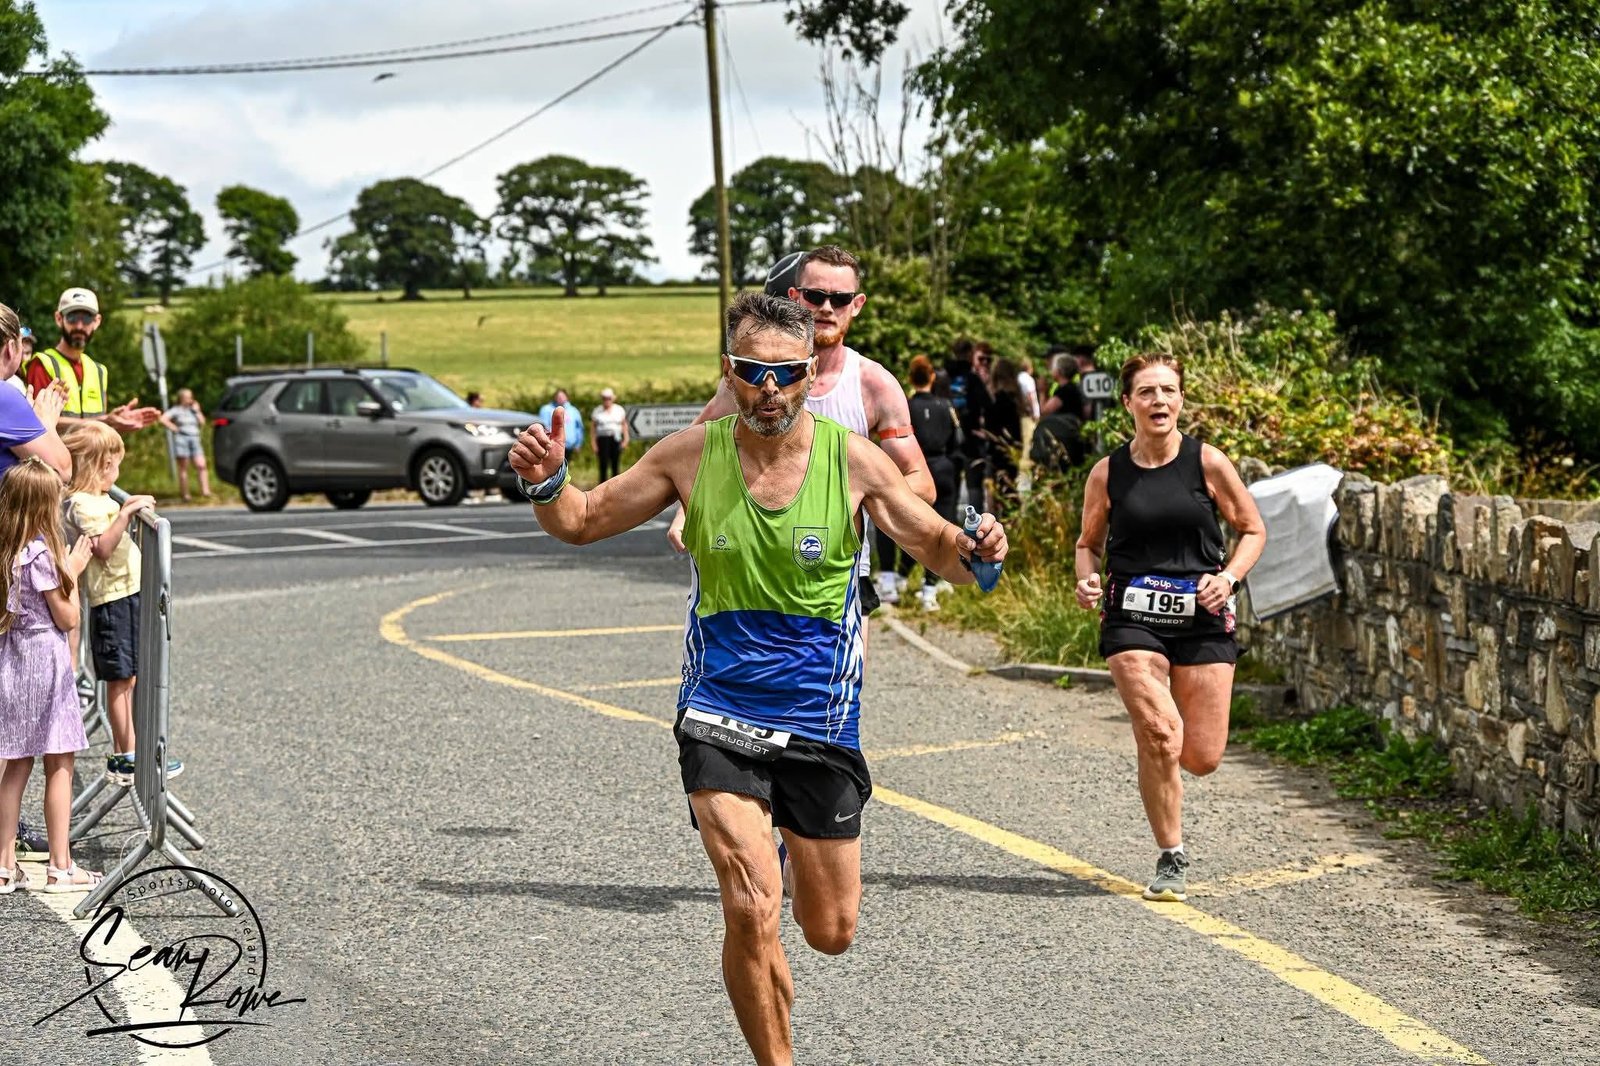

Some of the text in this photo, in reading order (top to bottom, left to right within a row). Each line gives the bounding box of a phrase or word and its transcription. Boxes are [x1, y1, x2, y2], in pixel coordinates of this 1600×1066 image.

[1144, 576, 1172, 590] Pop Up
[1146, 592, 1185, 614] 195
[1143, 616, 1185, 624] PEUGEOT
[710, 731, 770, 755] PEUGEOT
